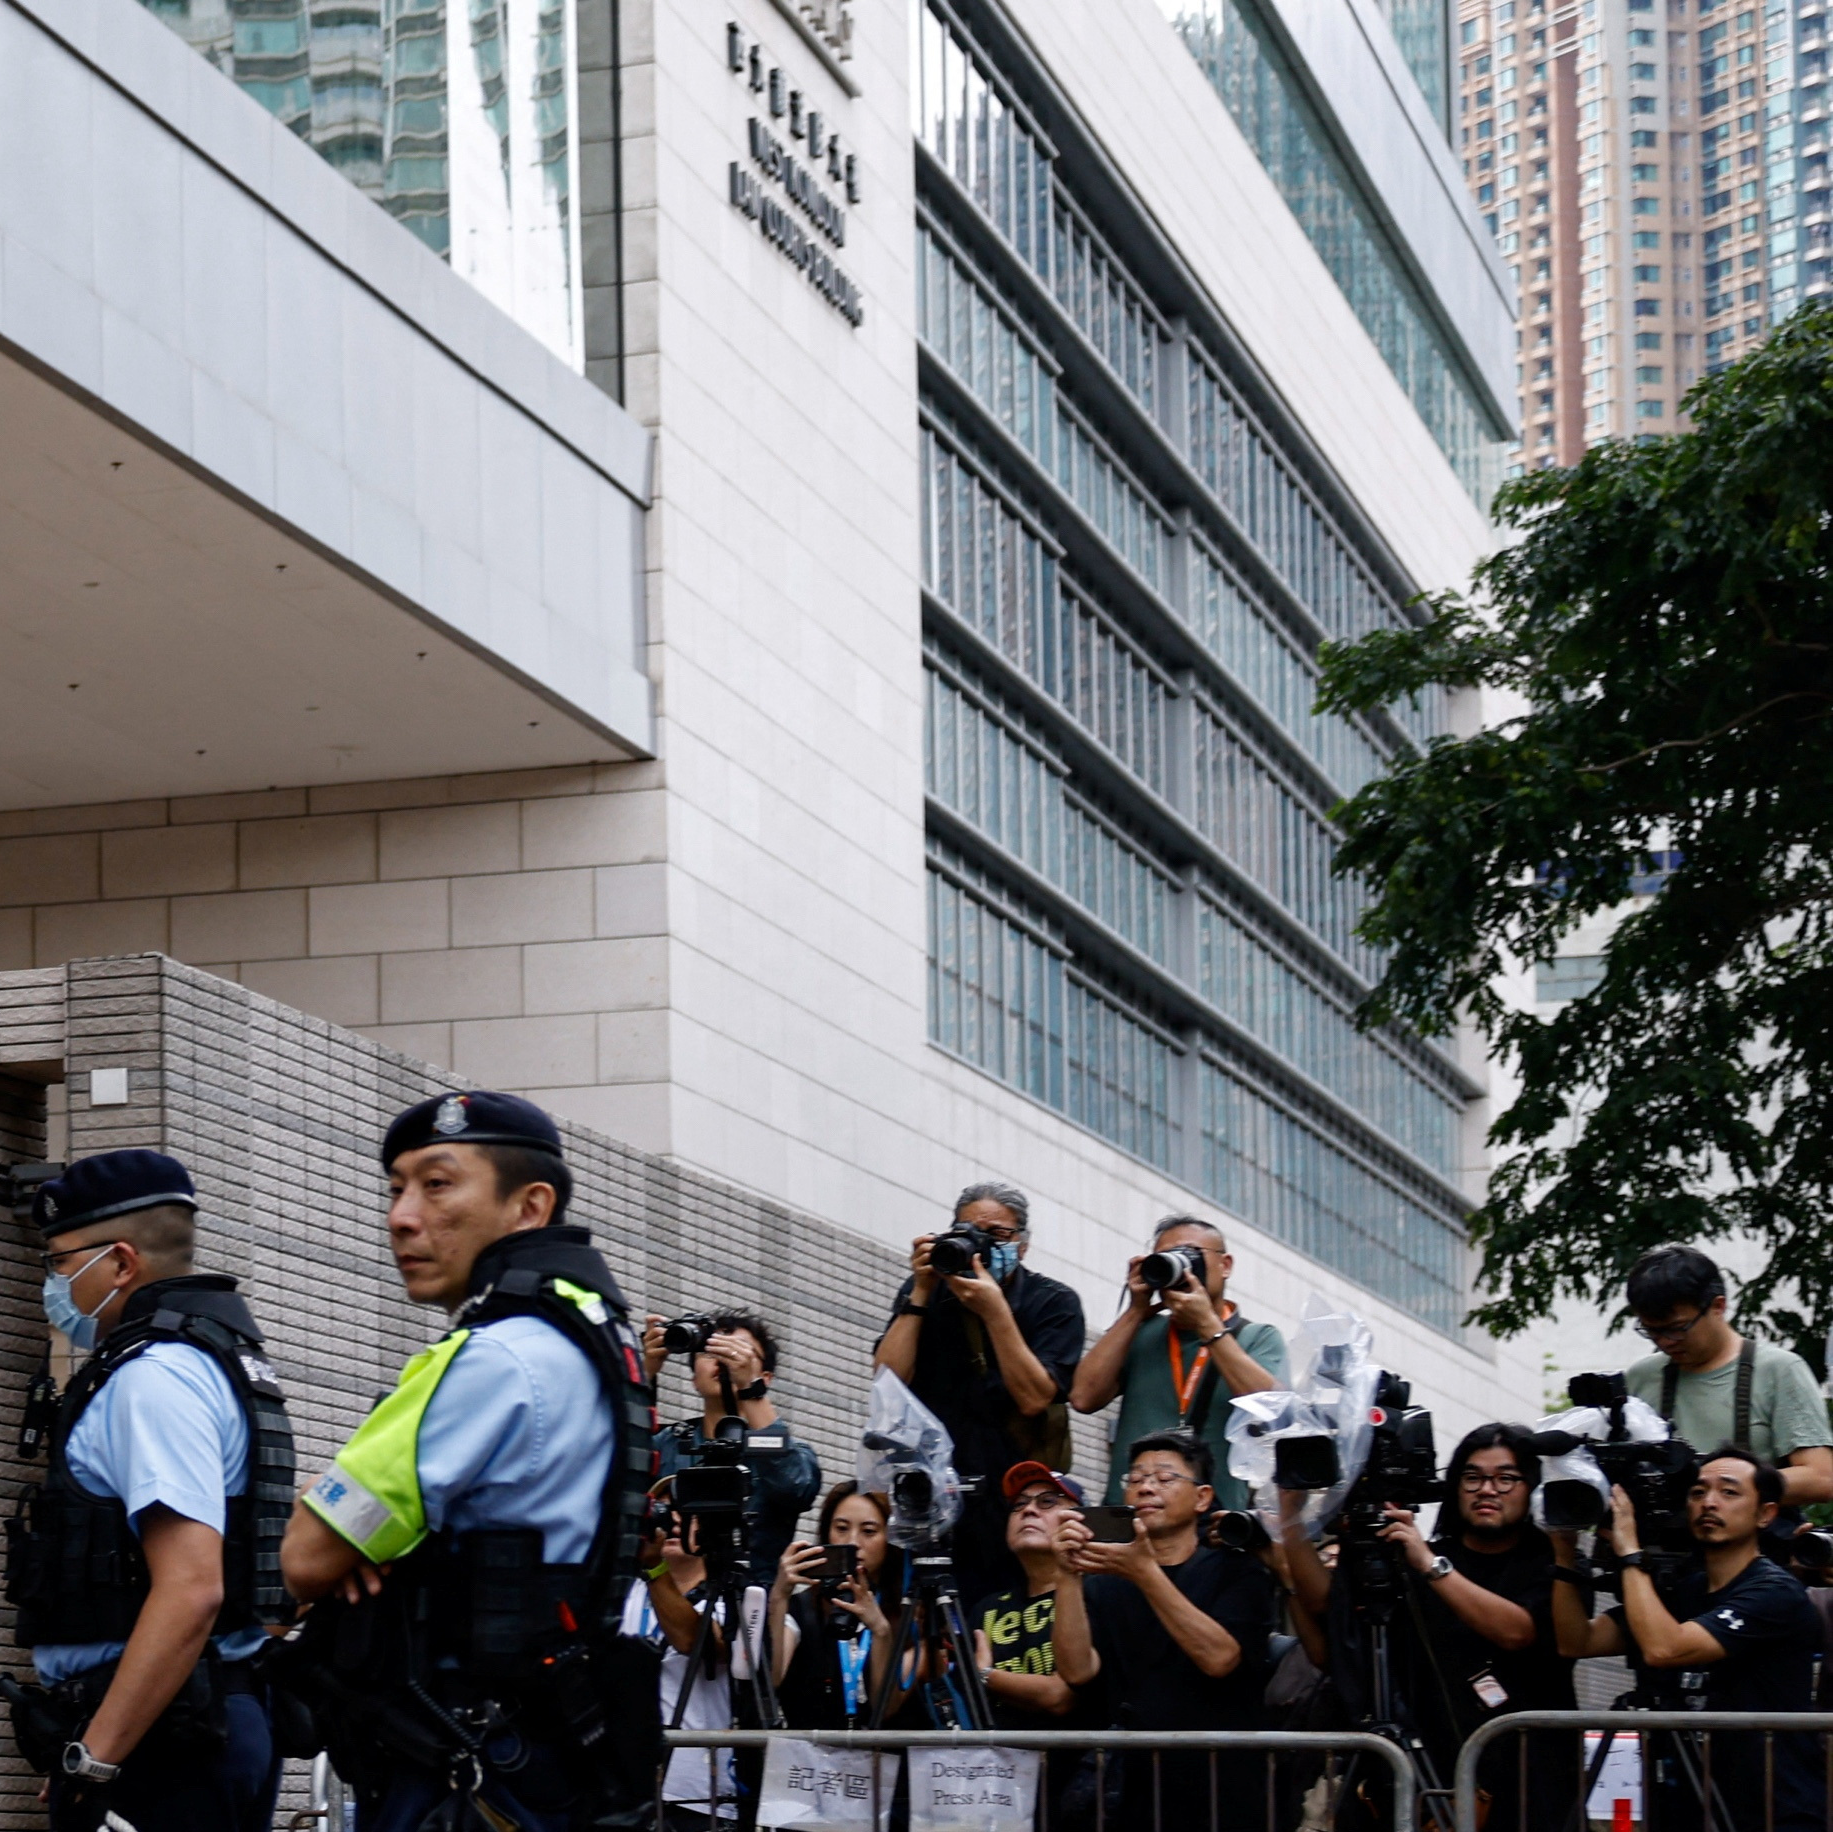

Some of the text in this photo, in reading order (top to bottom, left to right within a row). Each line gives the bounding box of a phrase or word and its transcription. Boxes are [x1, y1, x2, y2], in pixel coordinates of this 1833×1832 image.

[931, 1762, 1016, 1781] Designated
[787, 1764, 870, 1800] 記者區
[932, 1789, 1013, 1807] Press Area
